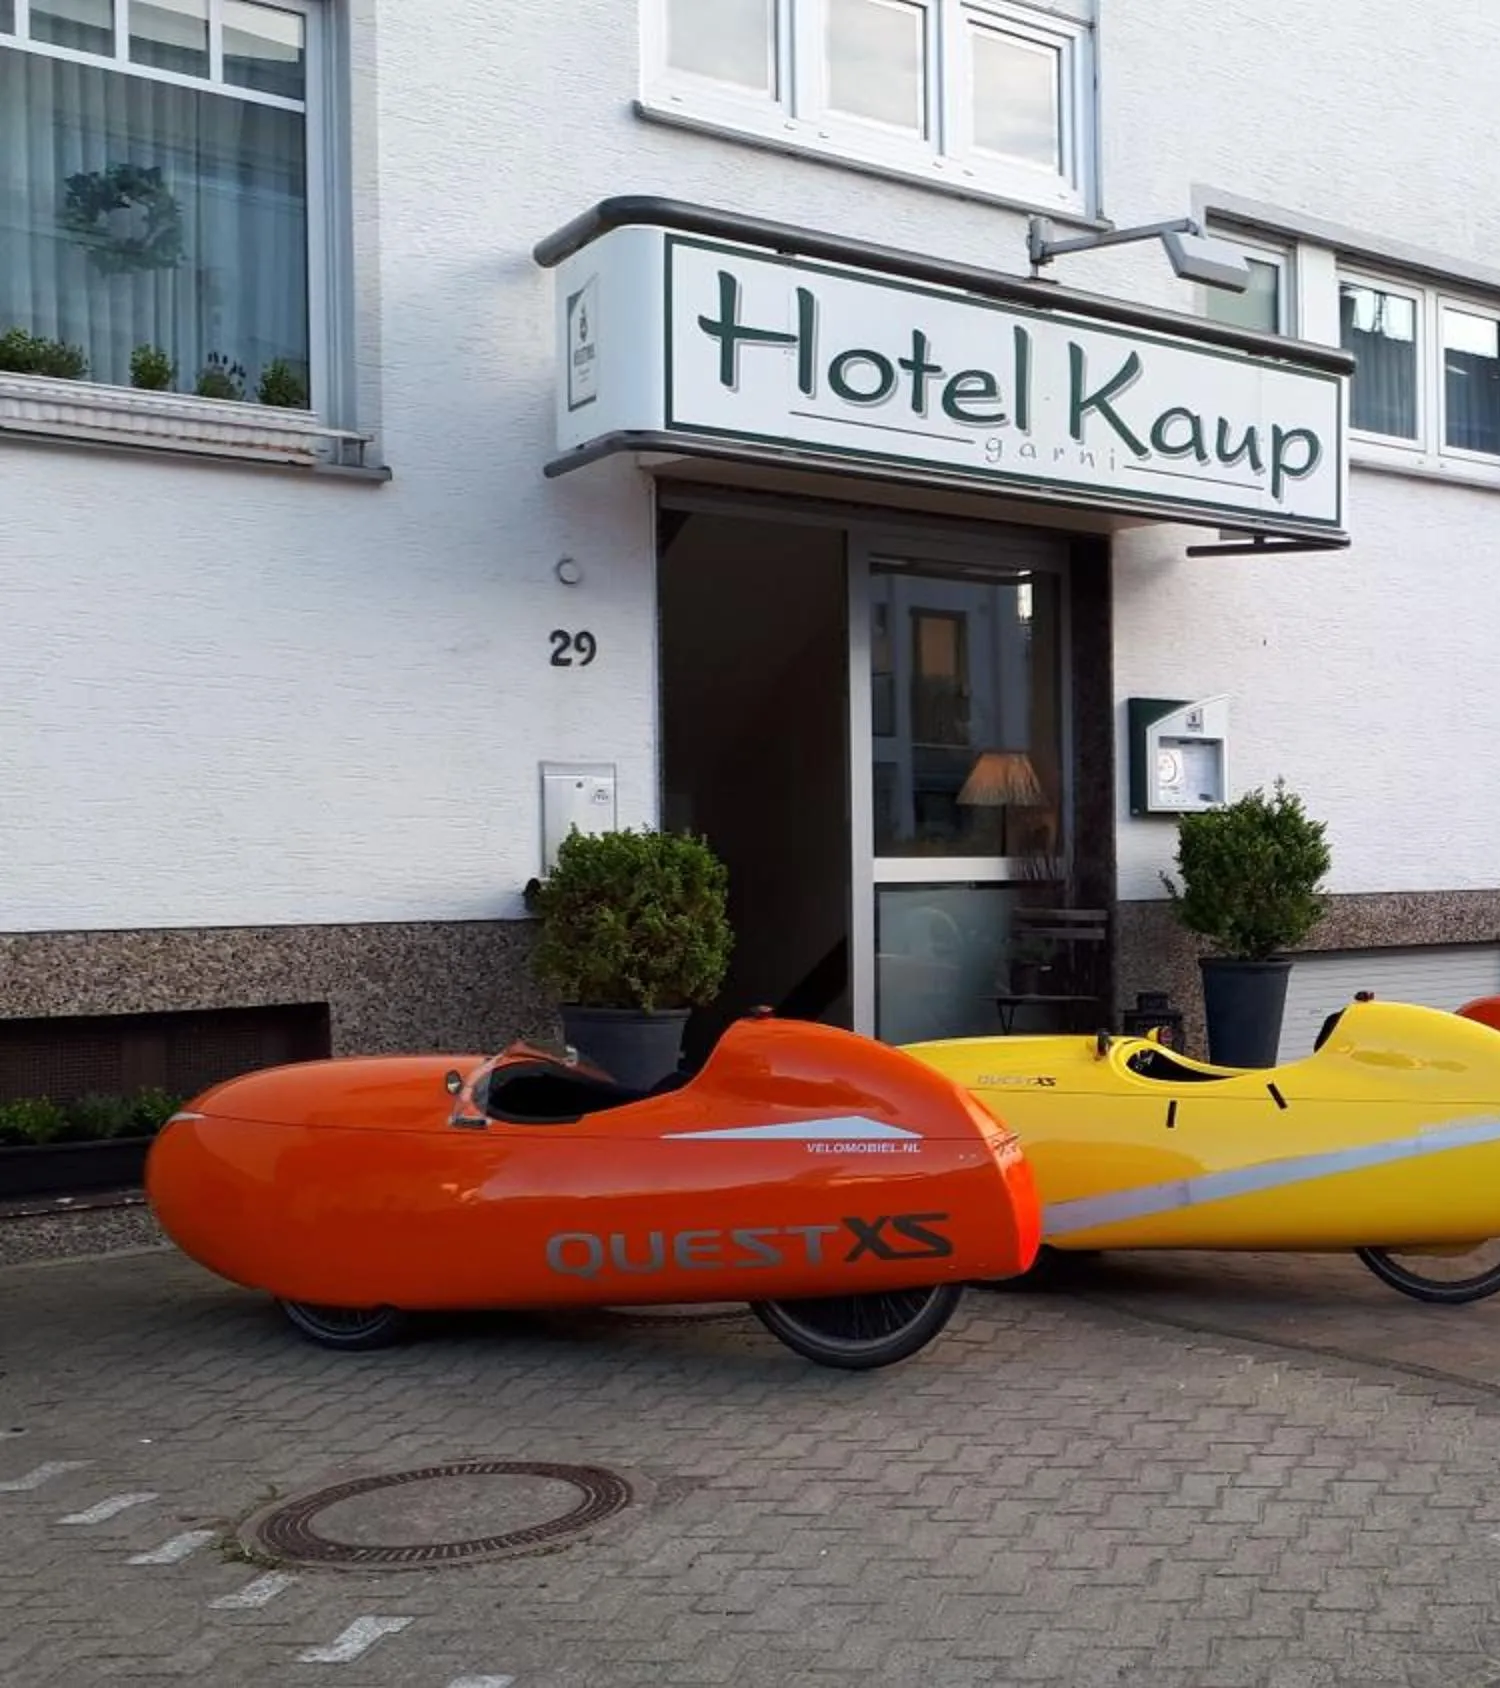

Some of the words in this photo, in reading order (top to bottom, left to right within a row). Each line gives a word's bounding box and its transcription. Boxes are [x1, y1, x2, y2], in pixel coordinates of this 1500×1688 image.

[697, 270, 1033, 433] Hotel
[1069, 340, 1321, 501] Kaup
[985, 437, 1115, 471] garni
[550, 629, 597, 667] 29
[806, 1142, 921, 1153] VELOMOBIEL.NL
